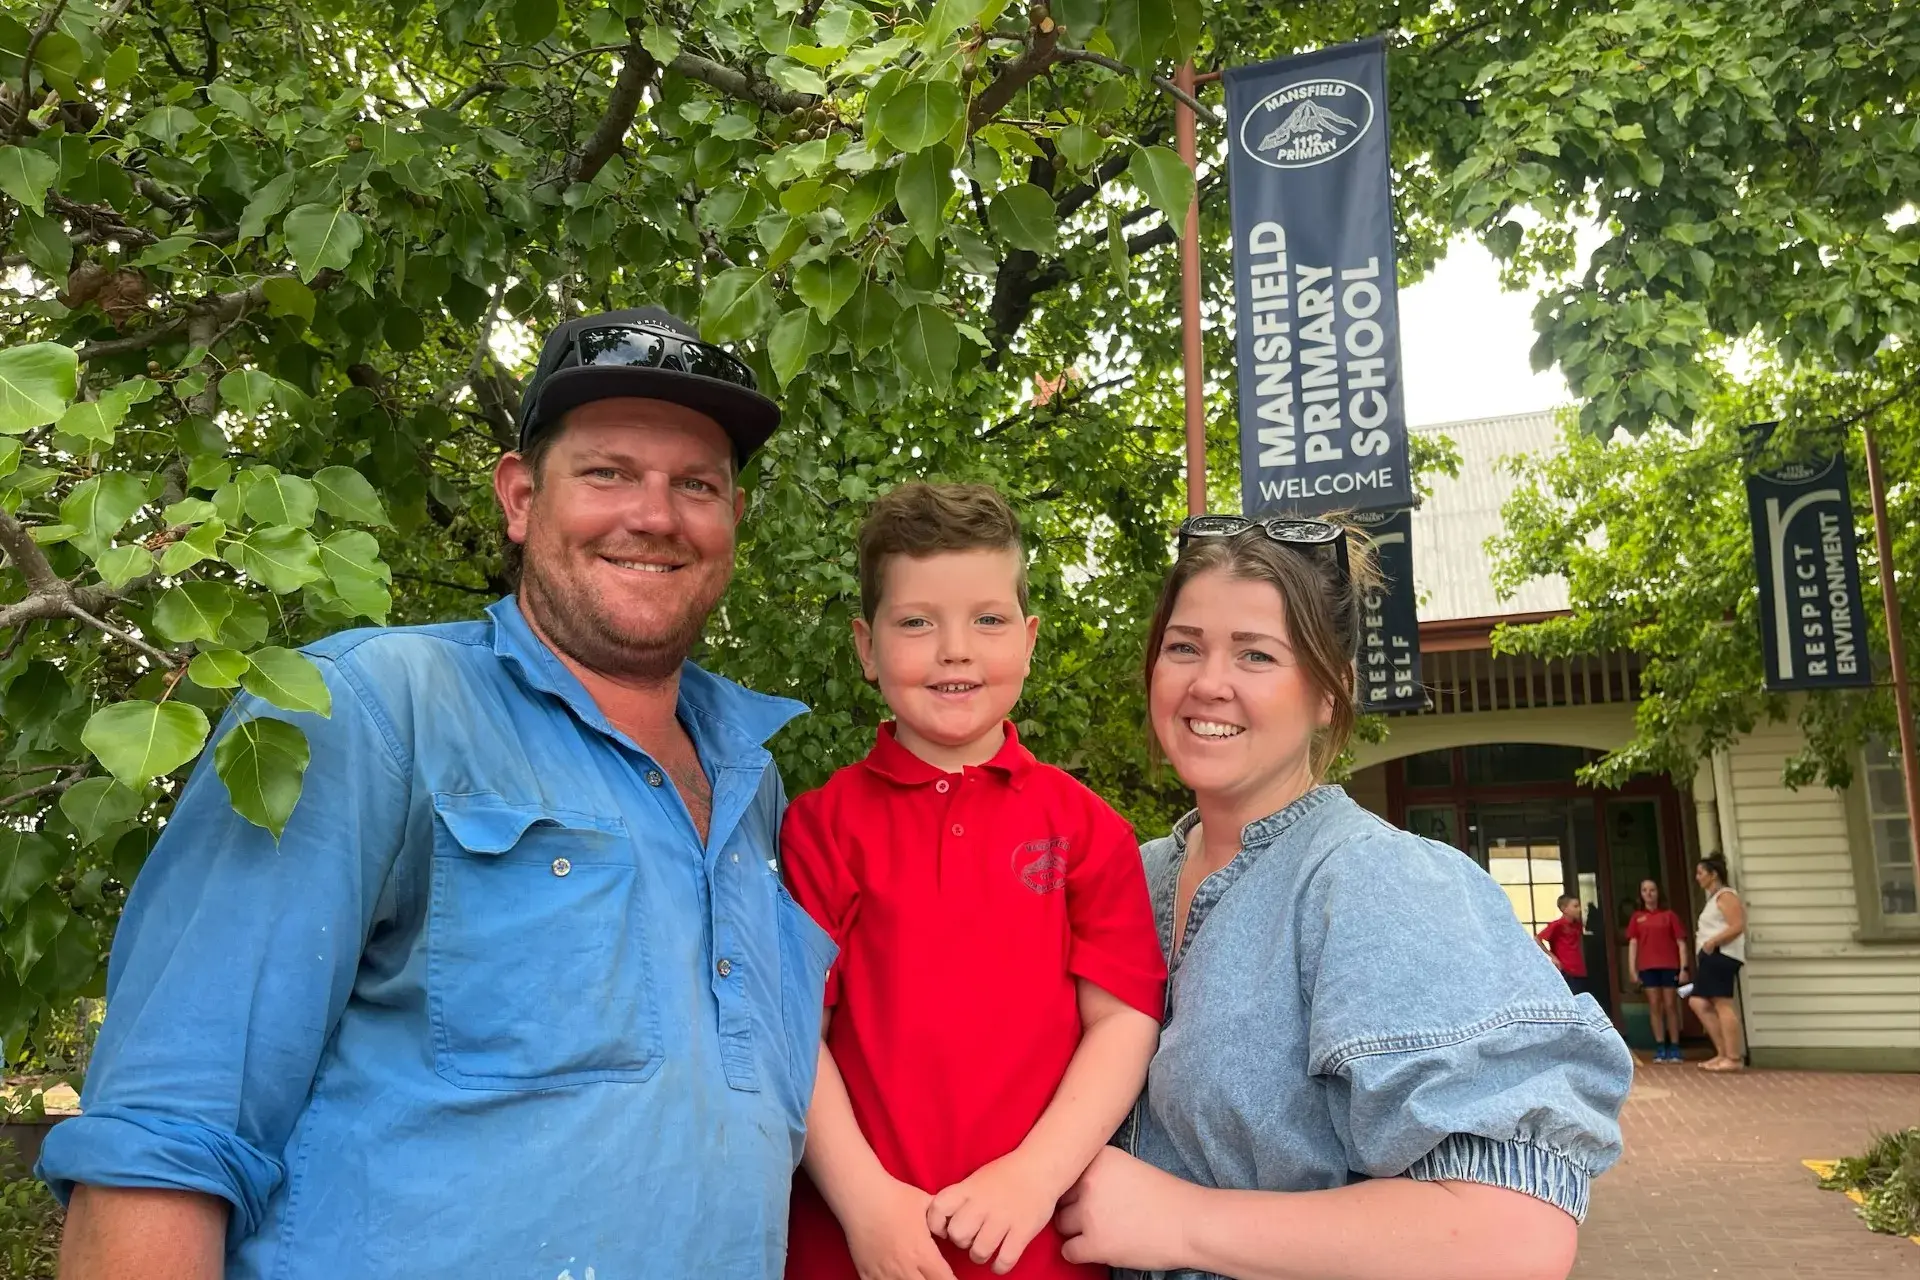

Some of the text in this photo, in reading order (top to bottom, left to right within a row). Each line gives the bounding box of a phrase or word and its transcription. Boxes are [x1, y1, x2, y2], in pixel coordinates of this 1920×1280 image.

[1264, 84, 1346, 112] MANSFIELD
[1277, 137, 1337, 160] PRIMARY
[1292, 133, 1322, 149] 1112
[1249, 221, 1297, 468] MANSFIELD
[1295, 264, 1343, 463] PRIMARY
[1341, 256, 1390, 457] SCHOOL
[1259, 467, 1393, 501] WELCOME
[1794, 544, 1828, 677] RESPECT
[1819, 511, 1857, 676] ENVIRONMENT
[1365, 594, 1387, 701] RESPEC
[1392, 635, 1413, 699] SELF
